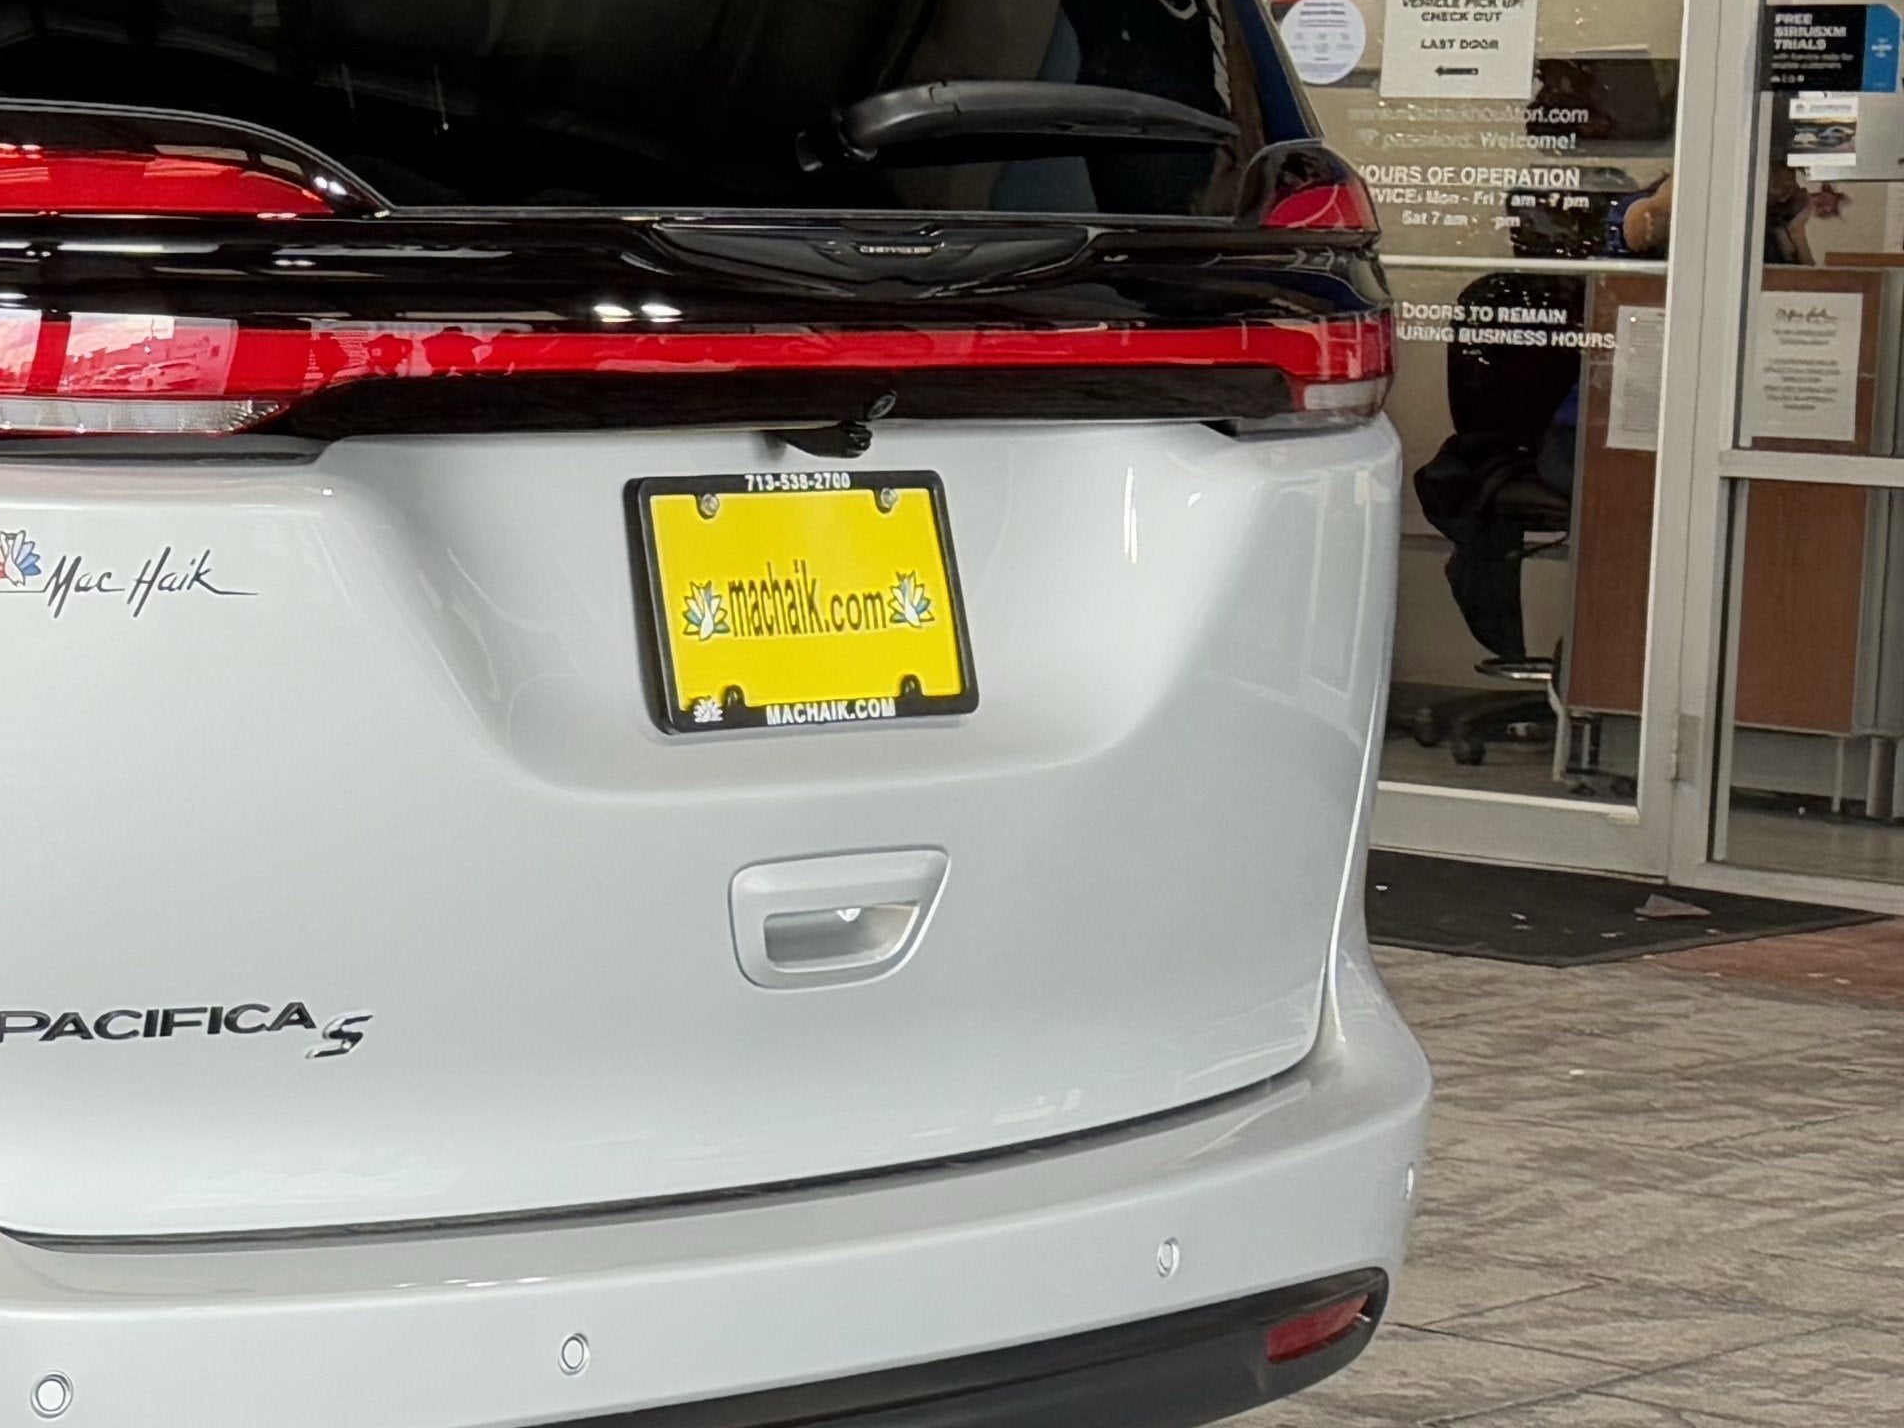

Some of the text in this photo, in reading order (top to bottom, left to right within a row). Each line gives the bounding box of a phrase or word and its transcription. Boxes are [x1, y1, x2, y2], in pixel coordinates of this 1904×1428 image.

[1421, 11, 1502, 22] CHECK OUT
[1774, 13, 1813, 25] FREE
[1420, 39, 1499, 50] LAST DOOR
[1774, 38, 1827, 51] TRIALS
[1480, 132, 1577, 149] Welcome!
[1359, 164, 1580, 188] OURS OF OPERATION
[1472, 190, 1495, 206] Fri
[1510, 194, 1536, 207] am
[1563, 195, 1590, 211] pm
[1401, 210, 1428, 225] Sat
[1443, 213, 1469, 226] am
[1401, 301, 1568, 324] DOORS TO REMAIN
[1458, 327, 1548, 346] BUSINESS
[42, 546, 259, 619] Mac Haik
[726, 558, 888, 639] machaik.com
[765, 697, 897, 726] MACHAIK.COM
[305, 1009, 374, 1060] S
